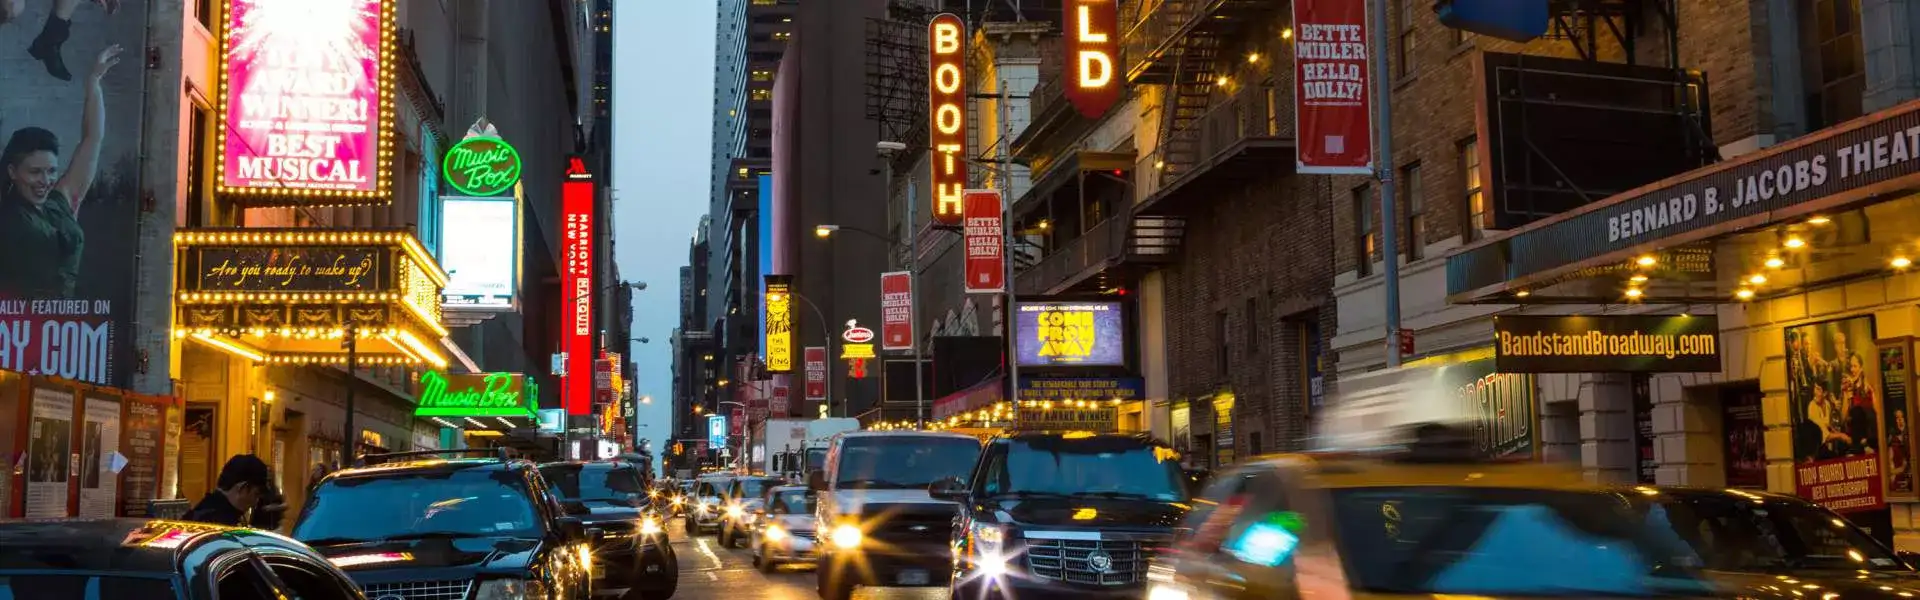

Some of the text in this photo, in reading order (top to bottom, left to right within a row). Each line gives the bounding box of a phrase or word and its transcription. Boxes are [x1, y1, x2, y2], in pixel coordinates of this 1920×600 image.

[1077, 0, 1113, 89] LD
[1301, 24, 1361, 42] BETTE
[1297, 42, 1367, 60] MIDLER
[1303, 63, 1363, 83] HELLO,
[1303, 82, 1363, 101] DOLLY!
[240, 93, 368, 122] WINNER!
[934, 22, 963, 215] BOOTH
[267, 132, 341, 158] BEST
[452, 144, 510, 170] Music
[236, 155, 367, 183] MUSICAL
[463, 164, 515, 189] Box
[1608, 125, 1920, 242] BERNARD B. JACOBS THEAT
[567, 213, 577, 239] NEW
[965, 226, 1001, 236] MIDLER
[967, 216, 1000, 227] BETTE
[579, 213, 589, 275] MARRIOTT
[234, 264, 260, 286] you
[264, 255, 299, 286] ready
[32, 300, 88, 314] FEATURED
[94, 300, 110, 314] ON
[1038, 311, 1094, 327] COME
[772, 337, 784, 345] THE
[1038, 325, 1095, 342] FROM
[1501, 330, 1716, 359] BandstandBroadway.com
[1037, 341, 1094, 357] AWAY
[420, 369, 519, 407] Music Box
[1798, 458, 1878, 486] TONY AWARD WINNER!
